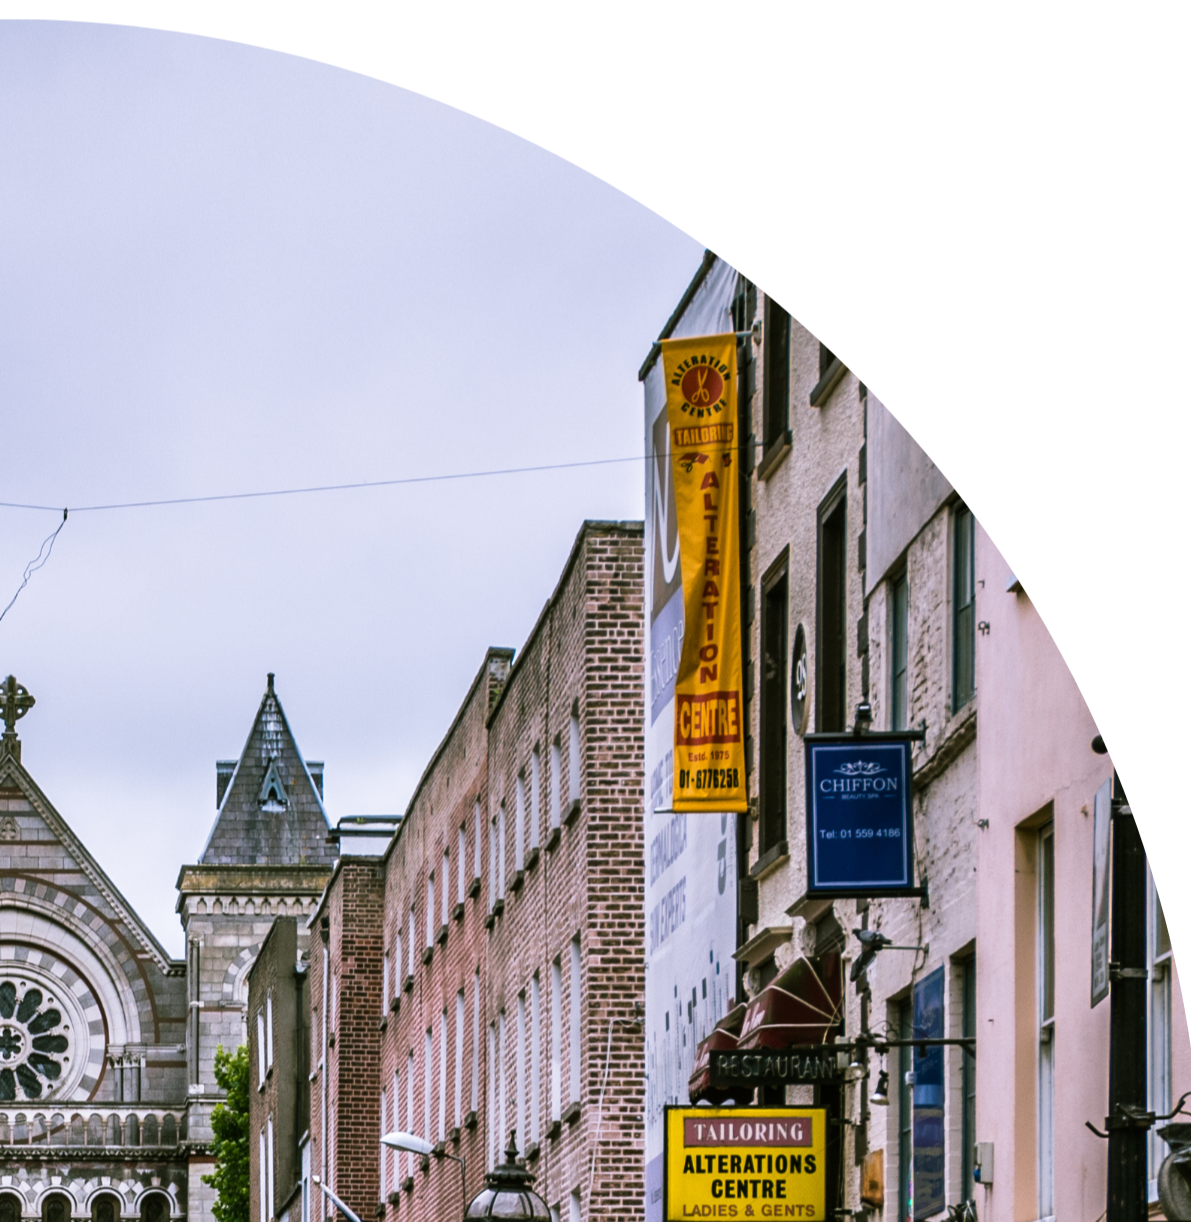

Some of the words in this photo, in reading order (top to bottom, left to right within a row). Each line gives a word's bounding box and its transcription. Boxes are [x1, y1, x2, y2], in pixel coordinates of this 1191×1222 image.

[671, 354, 731, 386] ALTERATION
[681, 398, 727, 418] CENTRE
[699, 471, 720, 684] ALTERATION
[680, 698, 738, 739] CENTRE
[711, 750, 729, 760] 1975
[820, 778, 898, 792] CHIFFON
[820, 829, 838, 839] Tel:
[840, 829, 852, 838] 01
[856, 829, 873, 838] 559
[876, 828, 900, 837] 4186
[694, 1122, 803, 1142] TAILORING
[683, 1154, 817, 1174] ALTERATIONS
[711, 1179, 786, 1198] CENTRE
[683, 1204, 738, 1217] LADIES
[745, 1204, 755, 1216] &
[761, 1204, 815, 1216] GENTS
